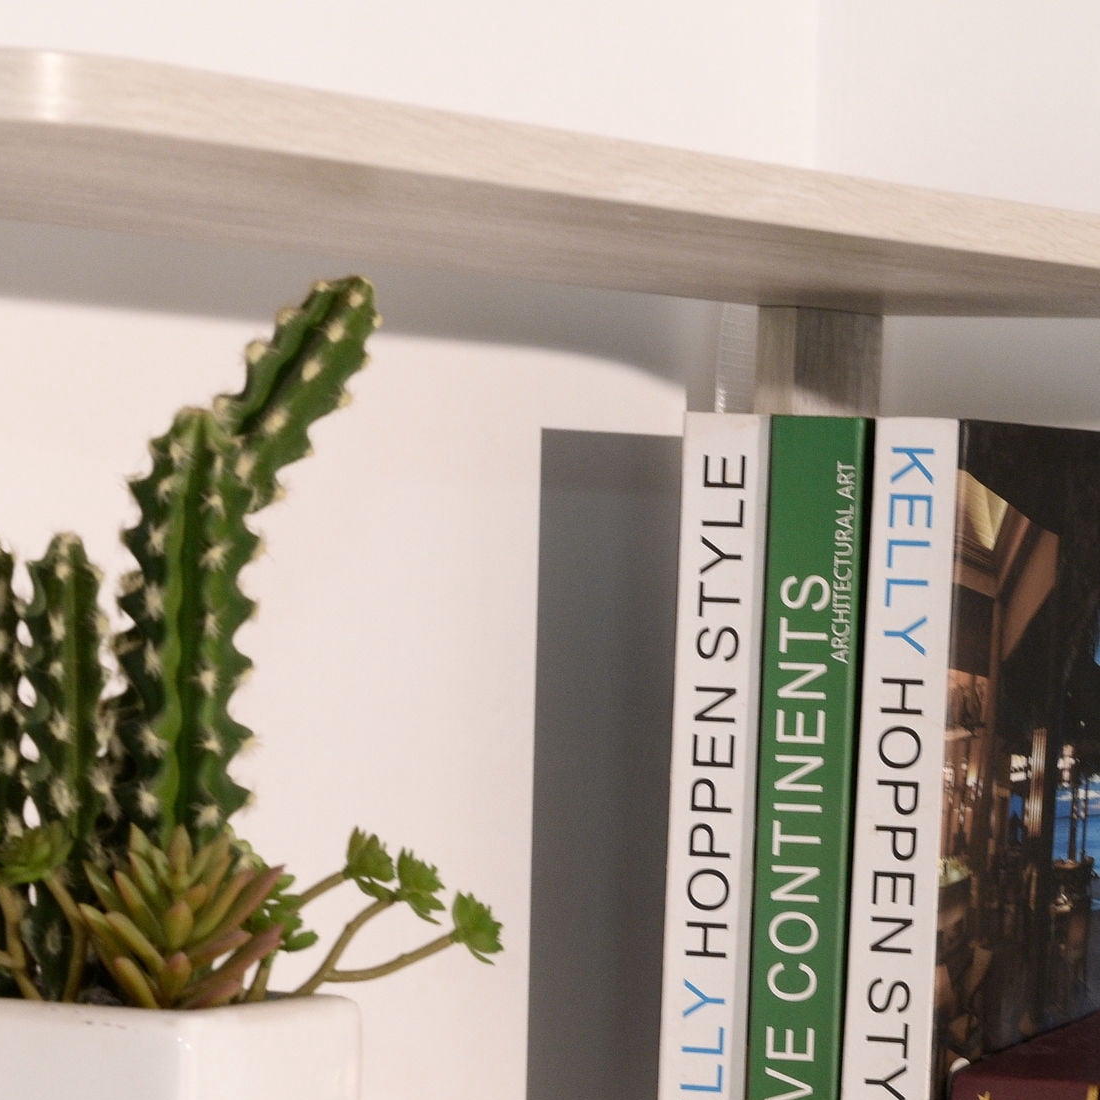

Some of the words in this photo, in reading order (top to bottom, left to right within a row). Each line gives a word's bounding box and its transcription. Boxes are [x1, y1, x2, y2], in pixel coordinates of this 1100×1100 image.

[696, 454, 746, 661] STYLE
[831, 503, 856, 664] ARCHITECTURAL
[837, 460, 857, 501] ART
[883, 446, 935, 656] KELLY
[684, 686, 737, 959] HOPPEN
[766, 574, 831, 1003] CONTINENTS
[869, 677, 925, 955] HOPPEN
